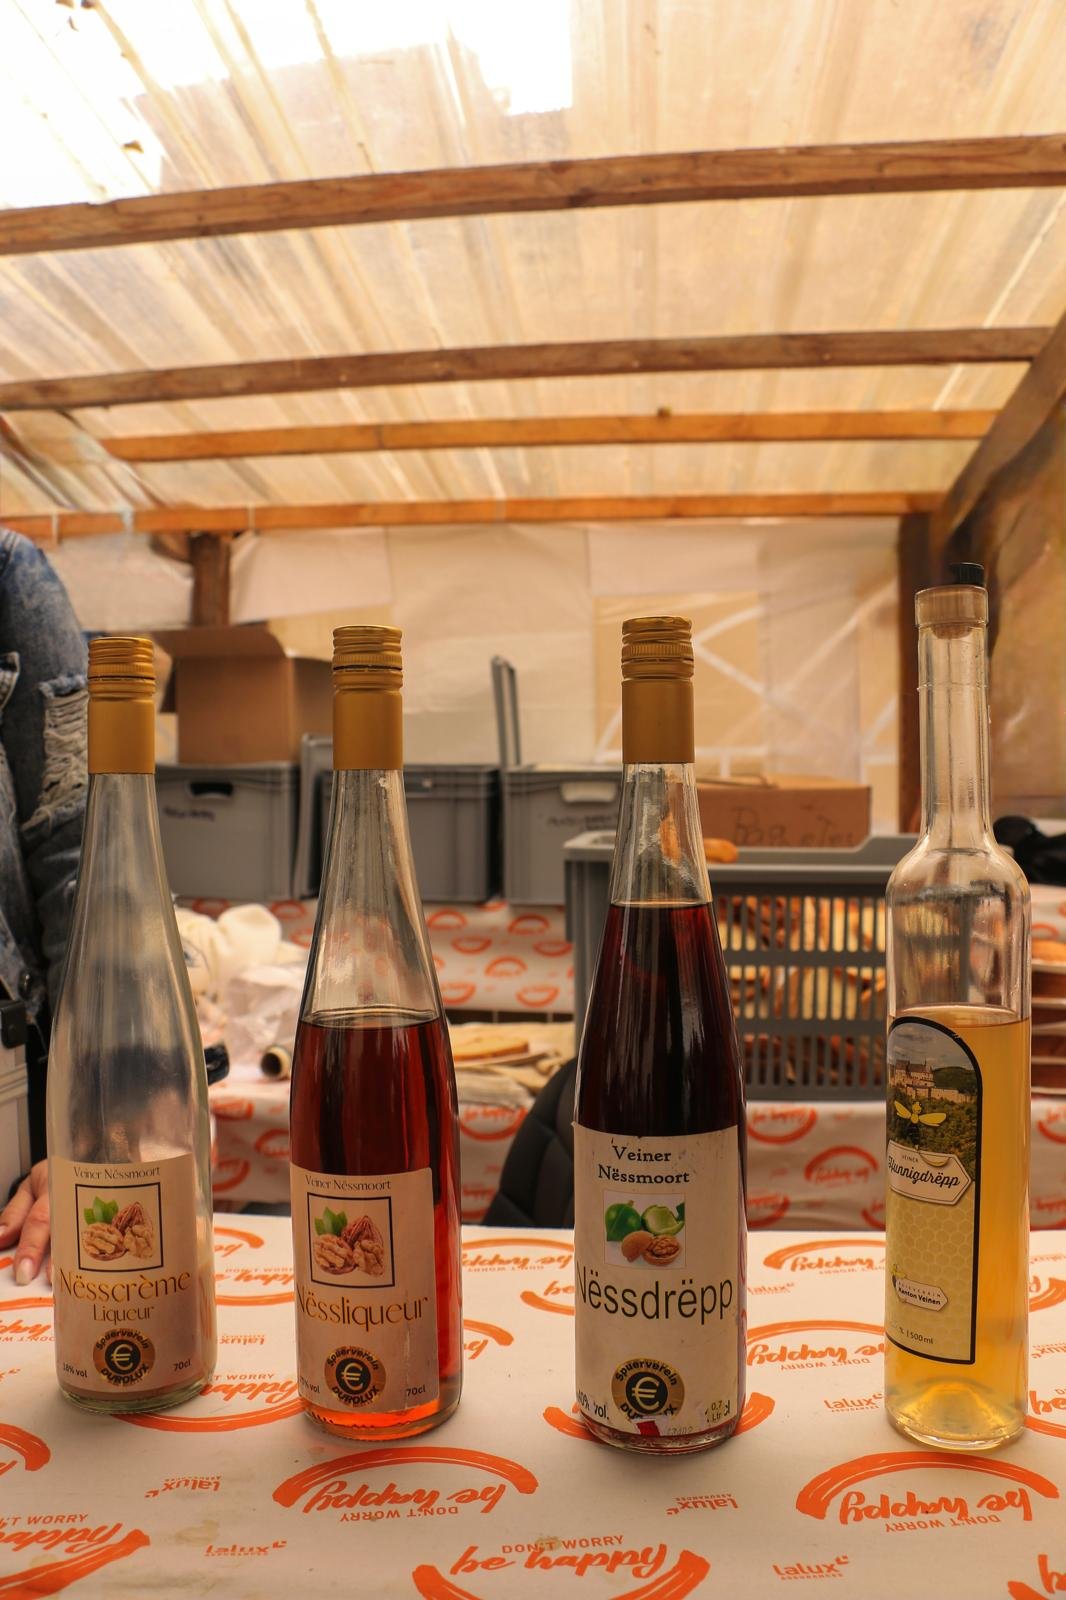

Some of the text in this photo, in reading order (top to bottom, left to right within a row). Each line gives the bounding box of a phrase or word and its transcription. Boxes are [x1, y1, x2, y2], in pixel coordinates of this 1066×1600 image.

[612, 1145, 672, 1162] Veiner
[73, 1166, 160, 1180] Veiner Nëssmoort
[598, 1164, 690, 1184] Nëssmoort
[305, 1174, 392, 1191] Veiner Nëssmoort
[60, 1267, 191, 1303] Nësscrème
[576, 1260, 734, 1326] Nëssdrëpp
[919, 1293, 942, 1306] Veinen
[93, 1304, 155, 1326] Liqueur
[296, 1285, 428, 1333] Nëssliqueur
[219, 1337, 266, 1346] lalux
[746, 1344, 848, 1366] happy
[75, 1369, 88, 1378] vol
[173, 1359, 192, 1372] 70cl
[615, 1359, 678, 1386] Spuerverein
[780, 1362, 827, 1372] WORRY
[100, 1364, 150, 1385] DUROLUX
[226, 1373, 275, 1381] WORRY
[309, 1383, 321, 1394] vol
[404, 1384, 427, 1397] 70cl
[824, 1397, 876, 1410] lalux
[161, 1478, 221, 1492] lalux
[302, 1481, 506, 1514] be happy
[680, 1497, 739, 1511] lalux
[340, 1506, 459, 1522] DON'T WORRY
[839, 1488, 1033, 1525] be happy
[27, 1513, 89, 1525] WORRY
[885, 1514, 1001, 1533] DON'T WORRY
[205, 1544, 270, 1554] lalux
[502, 1535, 625, 1555] DON'T WORRY
[449, 1543, 668, 1580] be happy
[772, 1562, 841, 1577] lalux
